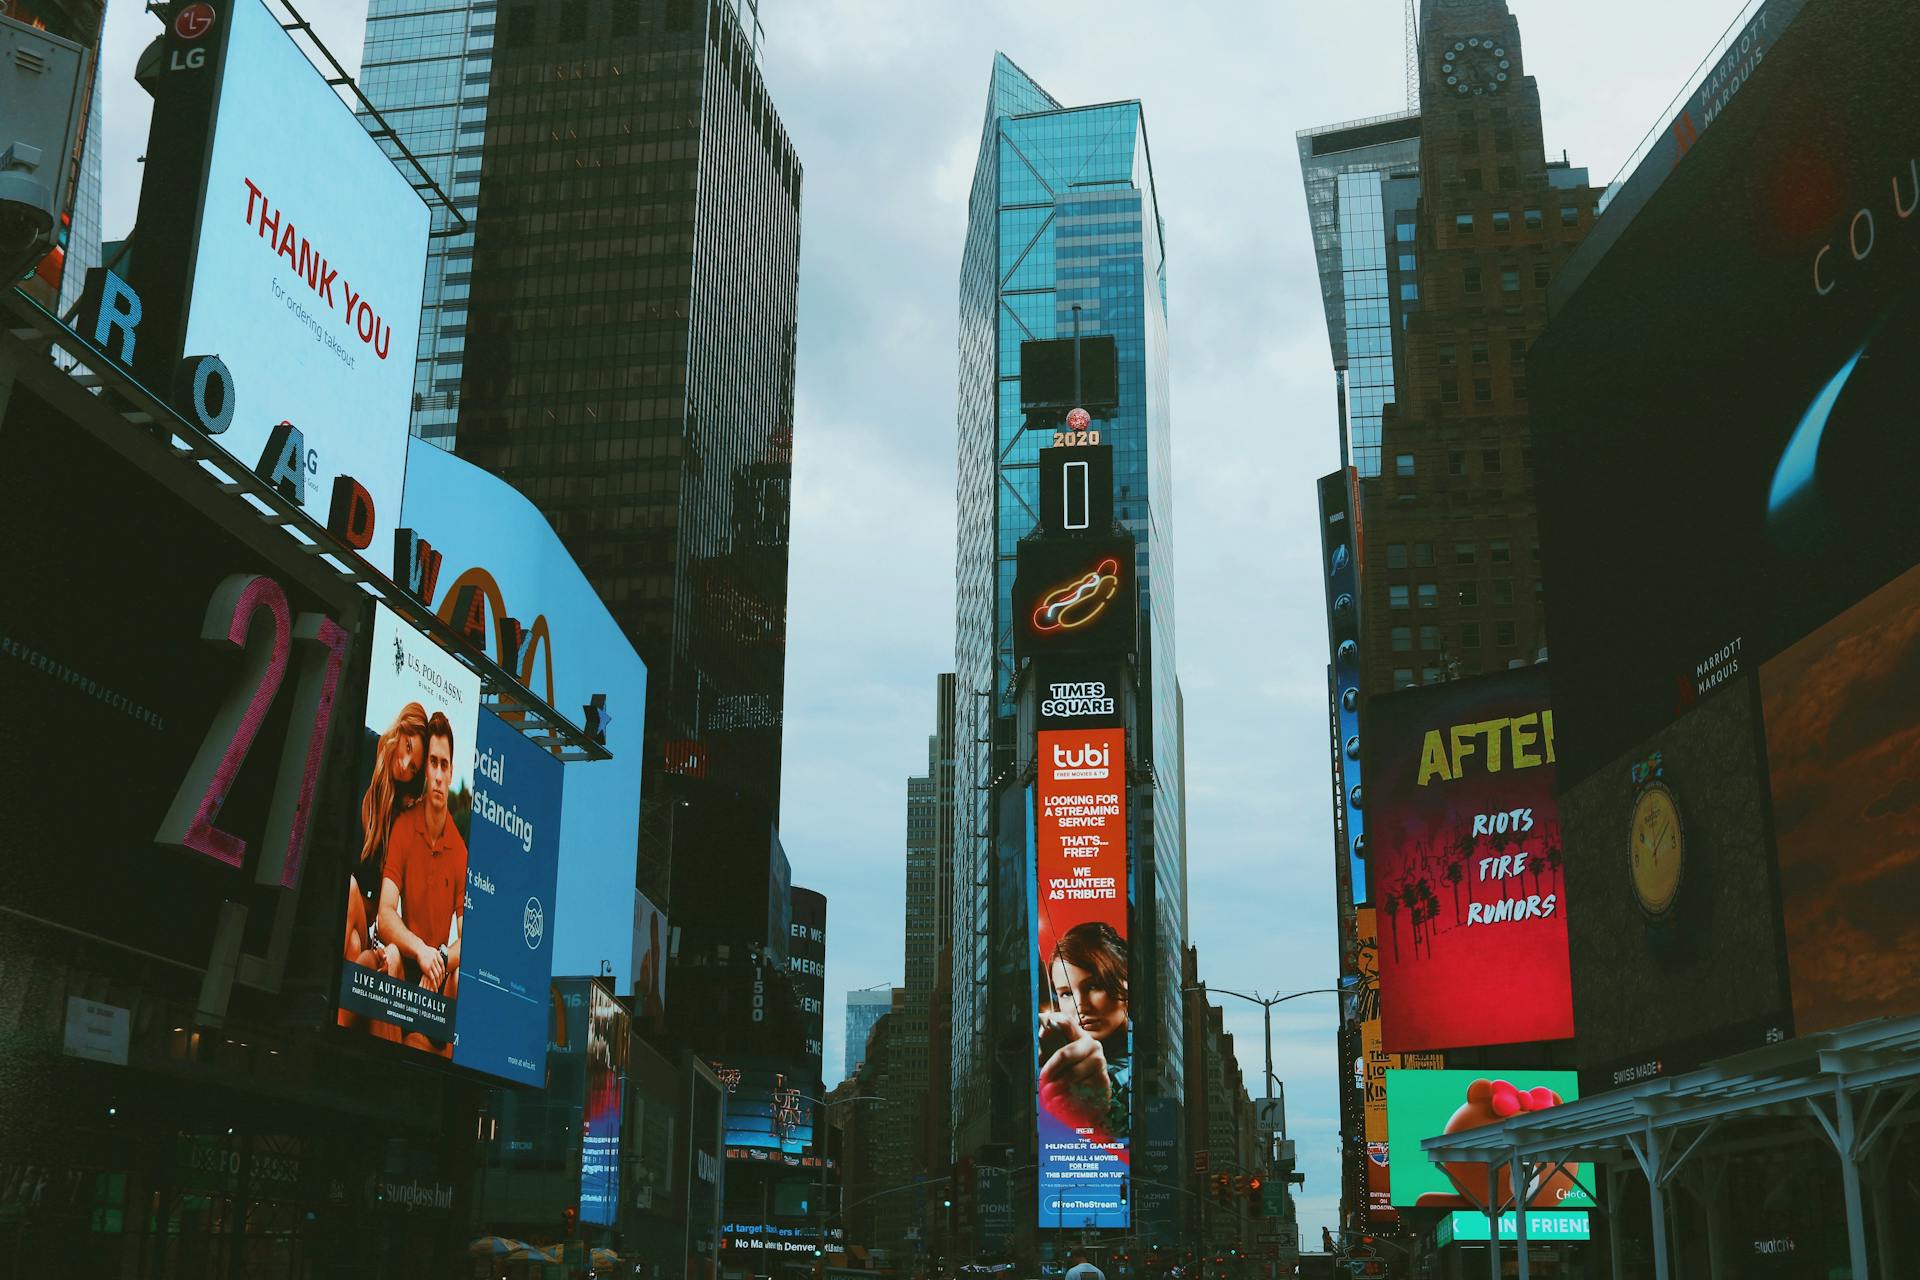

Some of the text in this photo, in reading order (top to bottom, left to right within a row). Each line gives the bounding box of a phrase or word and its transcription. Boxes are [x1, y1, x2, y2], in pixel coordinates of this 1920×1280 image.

[170, 47, 205, 71] LG
[1702, 10, 1767, 105] MARRIOTT
[1703, 46, 1763, 128] MARQUIS
[244, 176, 391, 360] THANK YOU
[272, 276, 355, 371] for ordering takeout
[1053, 430, 1100, 448] 2020
[303, 448, 318, 475] G
[1696, 637, 1742, 677] MARRIOTT
[408, 653, 463, 704] U.S. POLO ASSN.
[1698, 659, 1738, 695] MARQUIS
[1050, 682, 1105, 700] TIMES
[1042, 698, 1114, 716] SQUARE
[183, 575, 349, 890] 21
[1053, 742, 1109, 768] tubi
[1044, 794, 1118, 806] LOOKING FOR
[1044, 805, 1120, 817] A STREAMING
[1058, 816, 1105, 828] SERVICE
[1472, 807, 1533, 838] RIOTS
[1060, 835, 1109, 846] THAT'S...
[1063, 846, 1099, 858] FREE?
[1072, 866, 1091, 877] WE
[1479, 852, 1529, 882] FIRE
[474, 873, 496, 896] shake
[1049, 877, 1115, 888] VOLUNTEER
[1049, 888, 1116, 900] AS TRIBUTE!
[1467, 893, 1557, 927] RUMORS
[354, 971, 447, 1014] LIVE AUTHENTICALLY
[752, 967, 764, 1022] 1500
[1366, 1062, 1395, 1081] LIO
[1613, 1061, 1657, 1085] SWISS MADE
[1089, 1142, 1125, 1150] GAMES
[1049, 1154, 1076, 1162] STREAM
[1075, 1154, 1088, 1162] ALL
[736, 1224, 762, 1235] target
[735, 1239, 749, 1249] No
[784, 1241, 816, 1252] Denver
